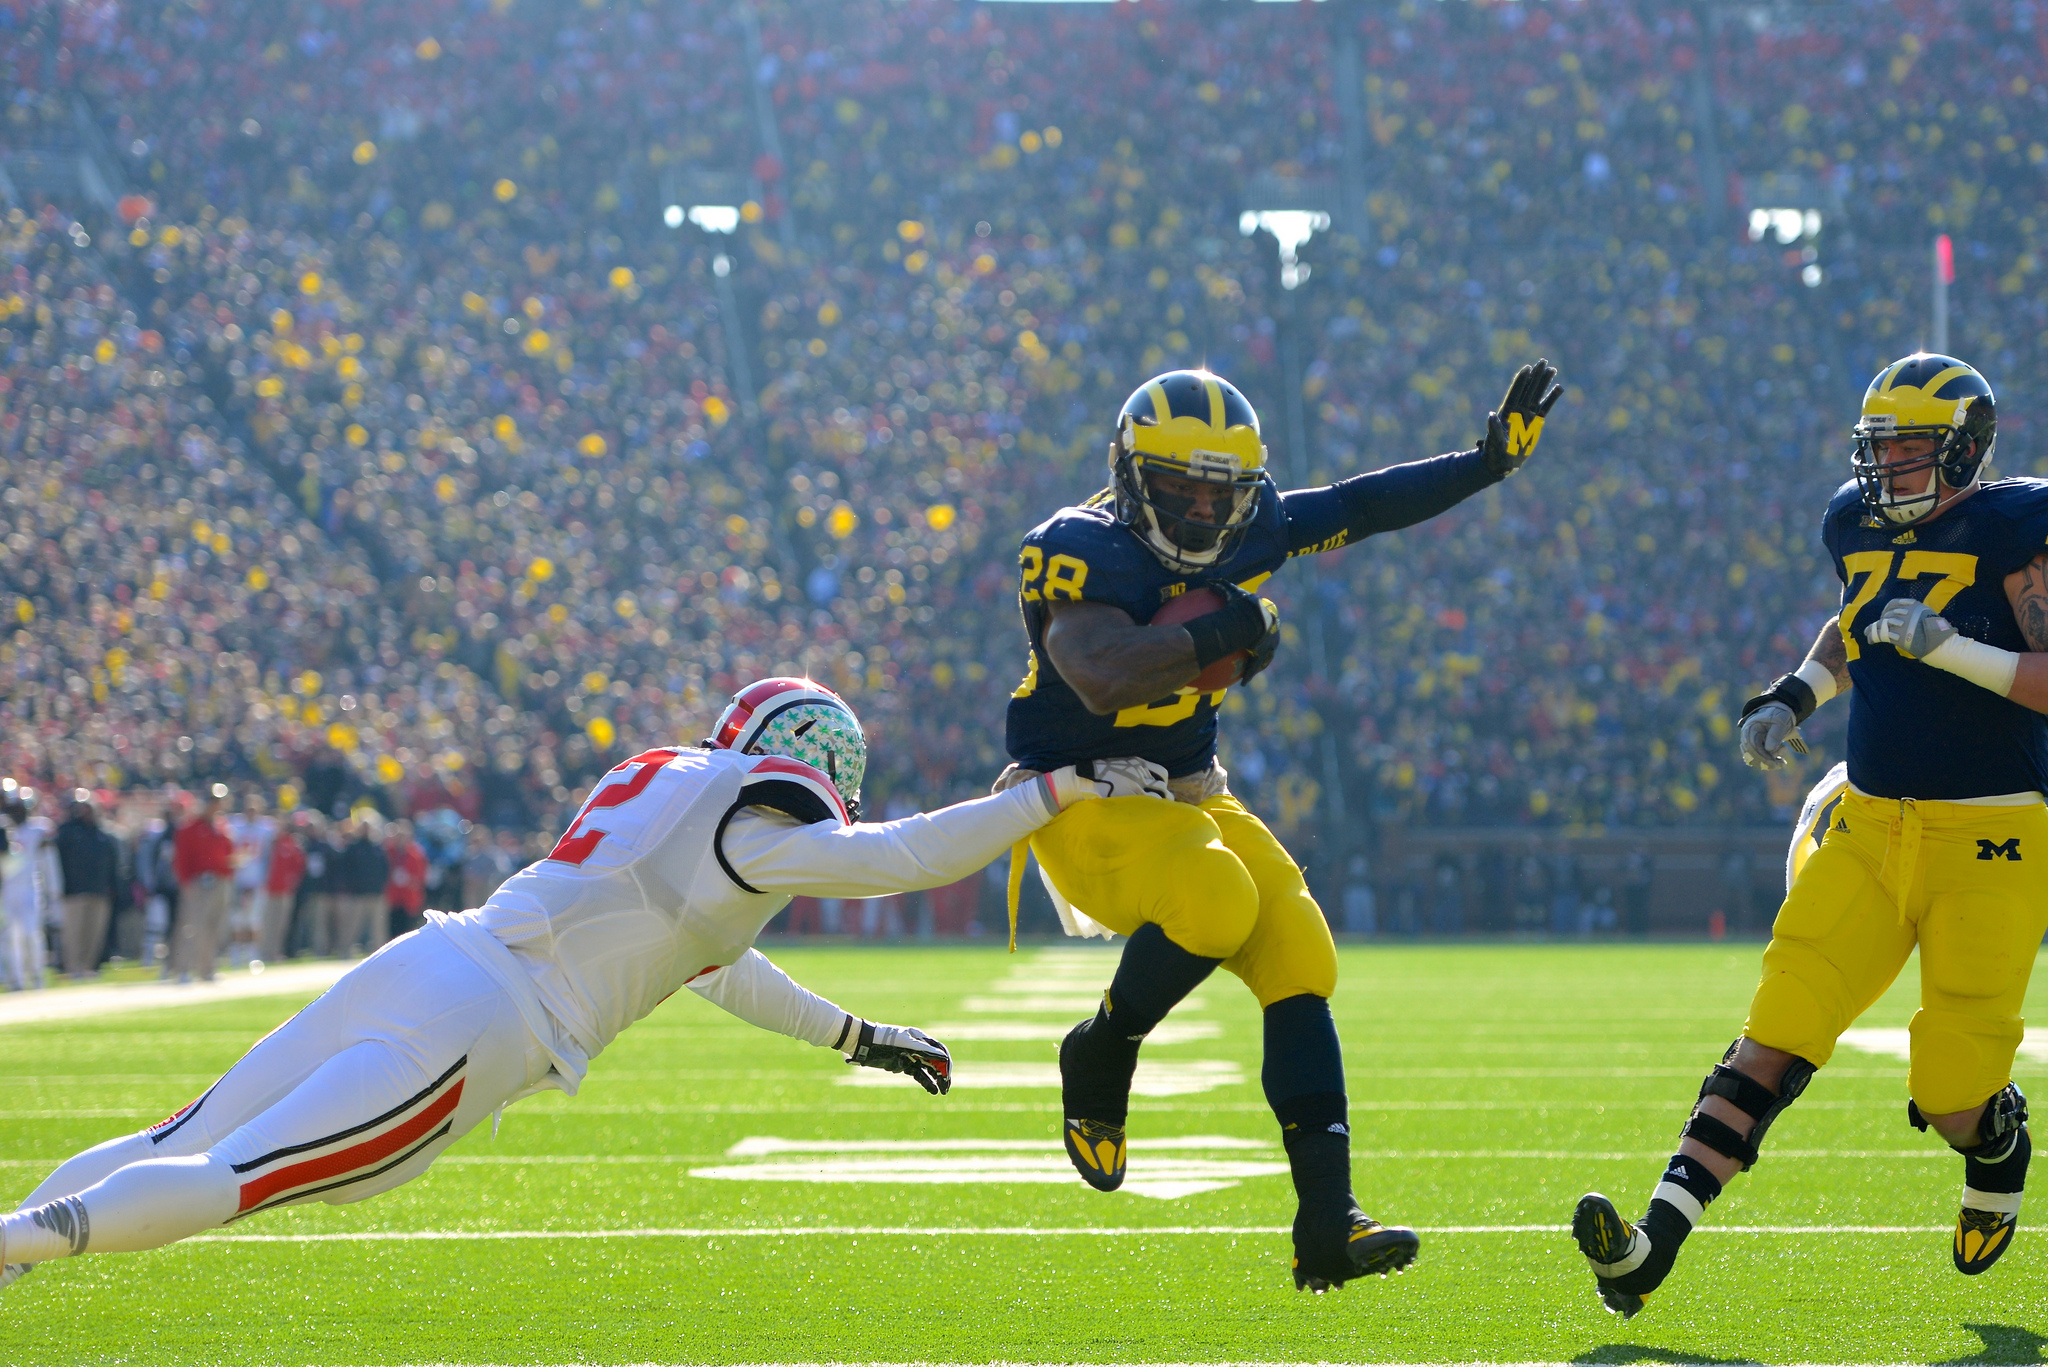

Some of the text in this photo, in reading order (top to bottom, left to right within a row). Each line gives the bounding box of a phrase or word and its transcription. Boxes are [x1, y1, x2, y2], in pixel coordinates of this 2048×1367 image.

[1202, 453, 1230, 465] MICHIGAN
[1506, 412, 1545, 456] M
[1018, 545, 1089, 602] 28
[1838, 551, 1979, 662] 77
[545, 750, 681, 869] 2
[1976, 838, 2022, 861] M
